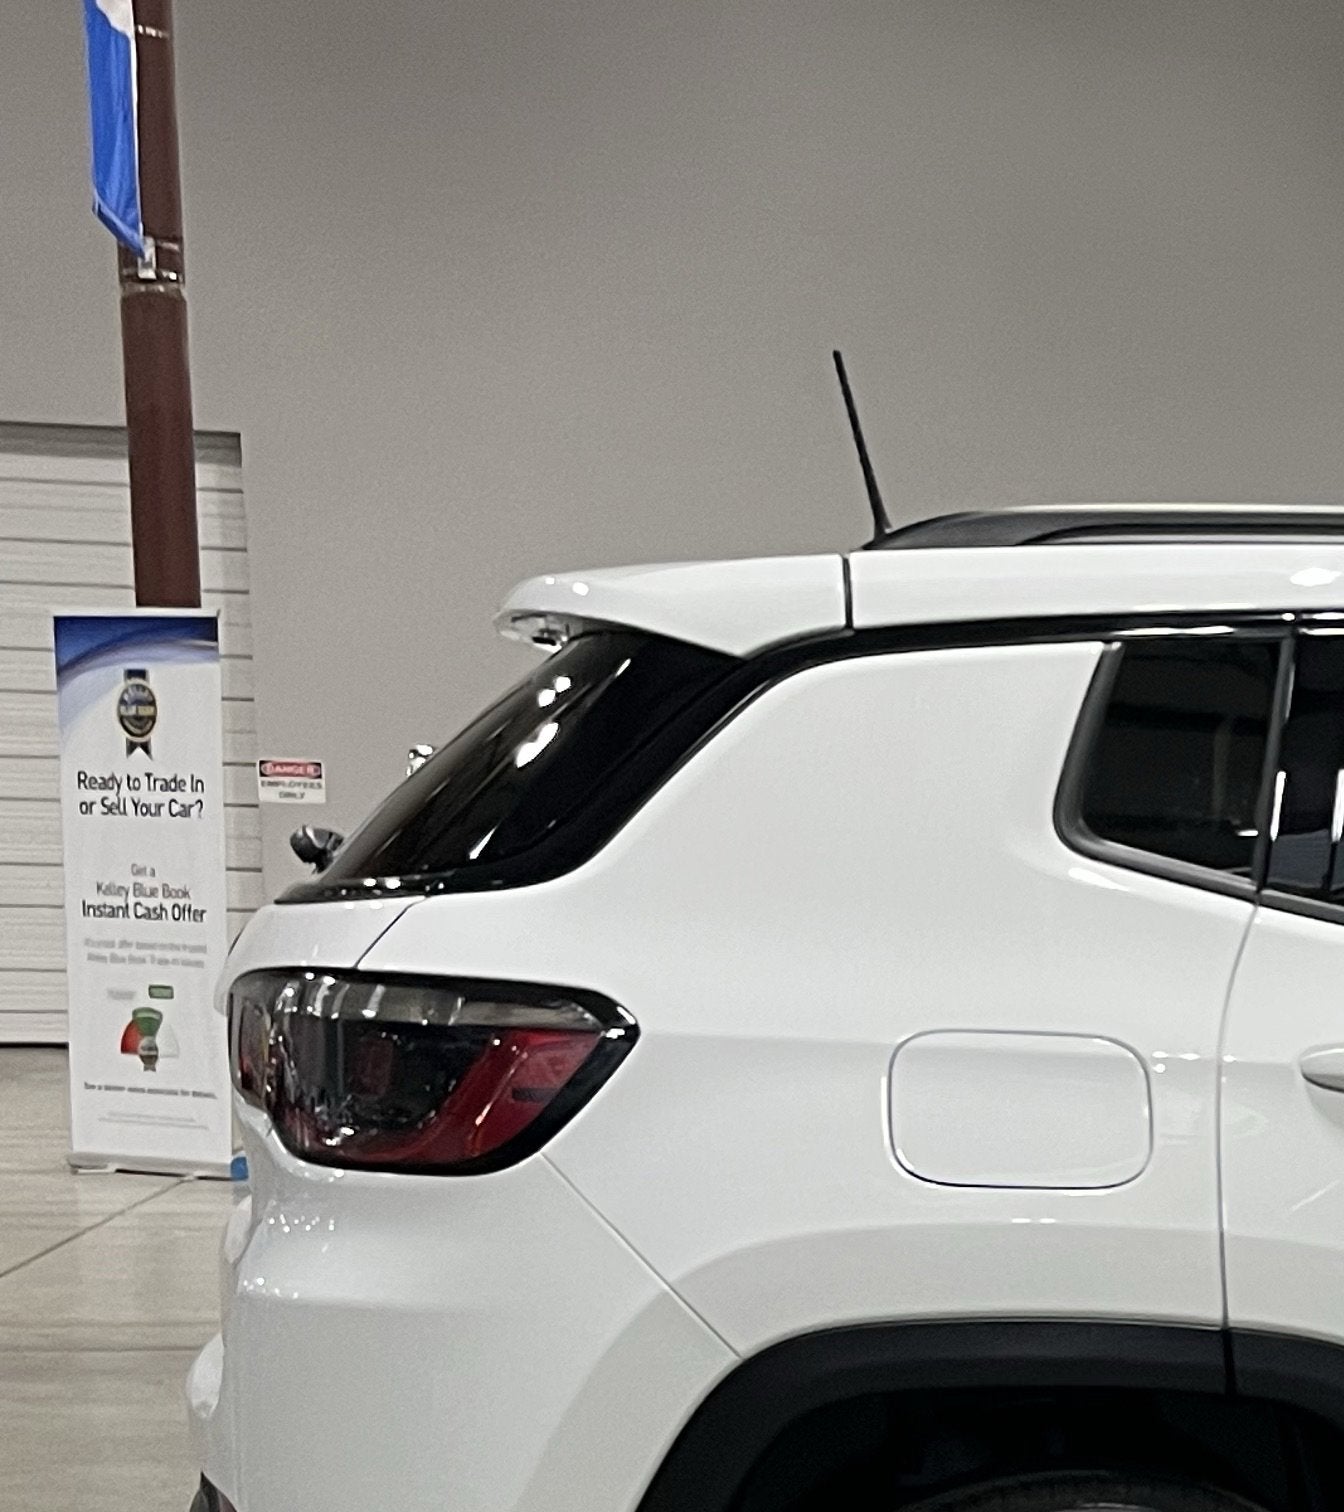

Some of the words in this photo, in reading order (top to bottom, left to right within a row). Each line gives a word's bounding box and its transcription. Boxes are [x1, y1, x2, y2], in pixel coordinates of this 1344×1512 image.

[77, 770, 122, 797] Ready
[126, 773, 141, 791] to
[145, 772, 187, 792] Trade
[190, 774, 205, 793] In
[79, 800, 97, 816] or
[100, 796, 128, 816] Sell
[131, 797, 165, 817] Your
[168, 798, 204, 819] Car?
[96, 881, 130, 902] Kelley
[133, 882, 159, 898] Blue
[162, 883, 191, 899] Book
[82, 899, 130, 919] Instant
[133, 901, 168, 921] Cash
[172, 903, 207, 923] Offer
